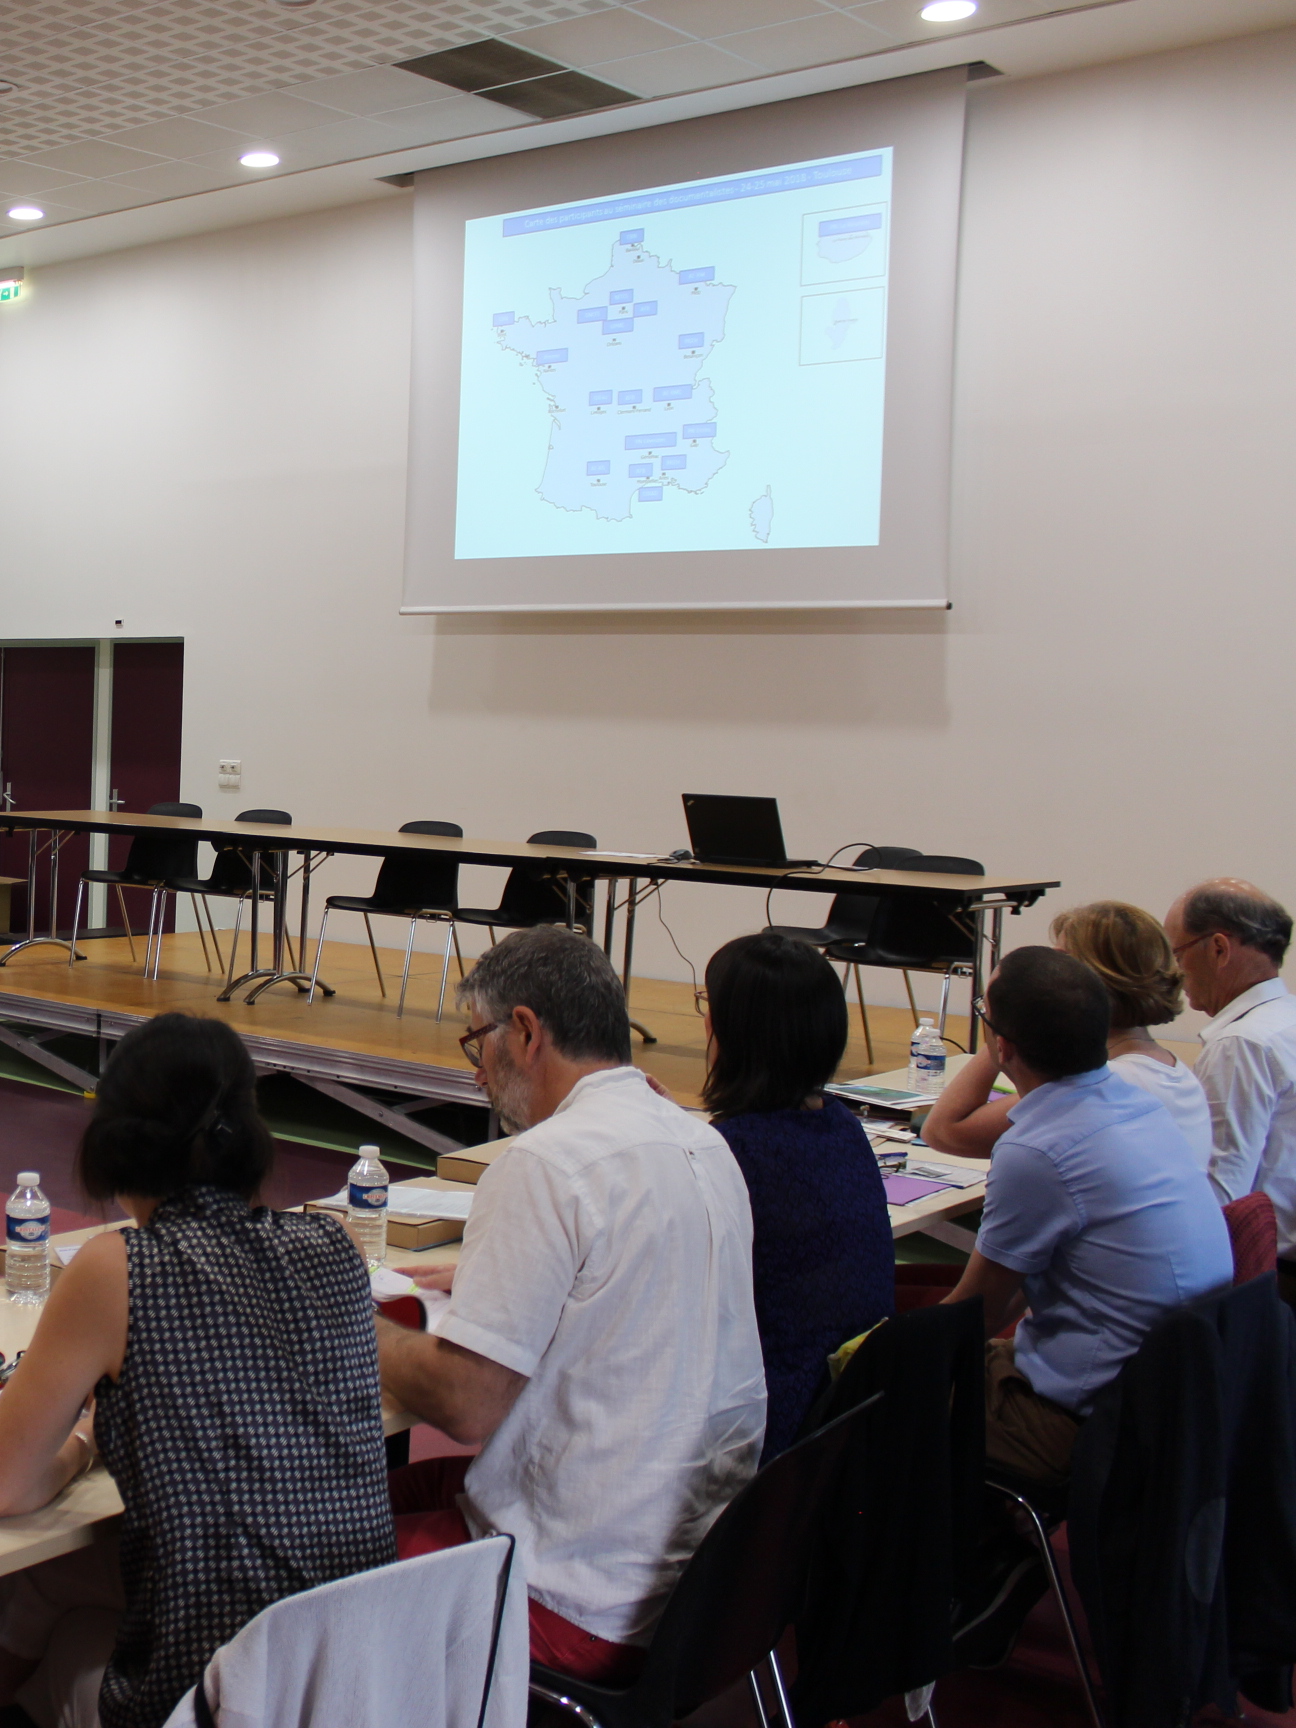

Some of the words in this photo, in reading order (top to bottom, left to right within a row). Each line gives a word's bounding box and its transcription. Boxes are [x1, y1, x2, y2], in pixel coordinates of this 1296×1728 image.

[524, 218, 543, 228] Carte
[545, 215, 558, 225] des
[559, 207, 603, 224] participants
[604, 206, 614, 214] au
[615, 199, 652, 213] séminaire
[653, 197, 667, 207] des
[669, 186, 735, 204] documentalistes
[741, 180, 764, 192] 24-25
[766, 178, 782, 189] mai
[813, 166, 852, 180] Toulouse
